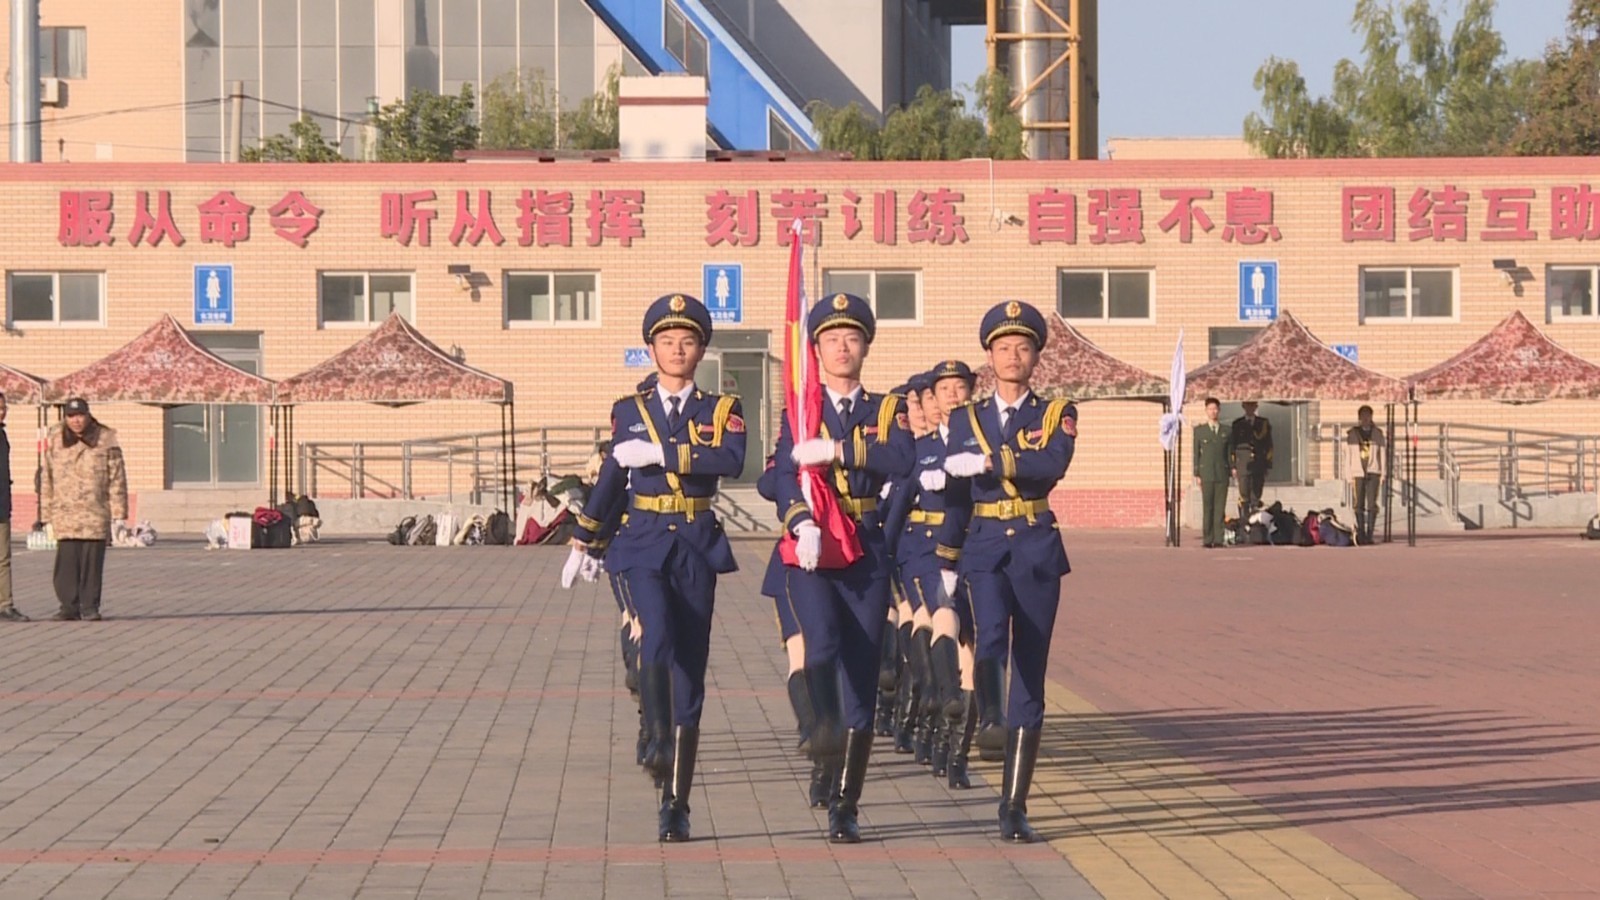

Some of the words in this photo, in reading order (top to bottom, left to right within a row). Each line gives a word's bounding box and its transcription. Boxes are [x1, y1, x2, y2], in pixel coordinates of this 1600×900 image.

[58, 190, 324, 247] 服从命令
[380, 189, 645, 247] 听从指挥
[705, 188, 968, 246] 刻苦训练
[1028, 187, 1282, 245] 自强不息
[1341, 184, 1600, 243] 团结互助
